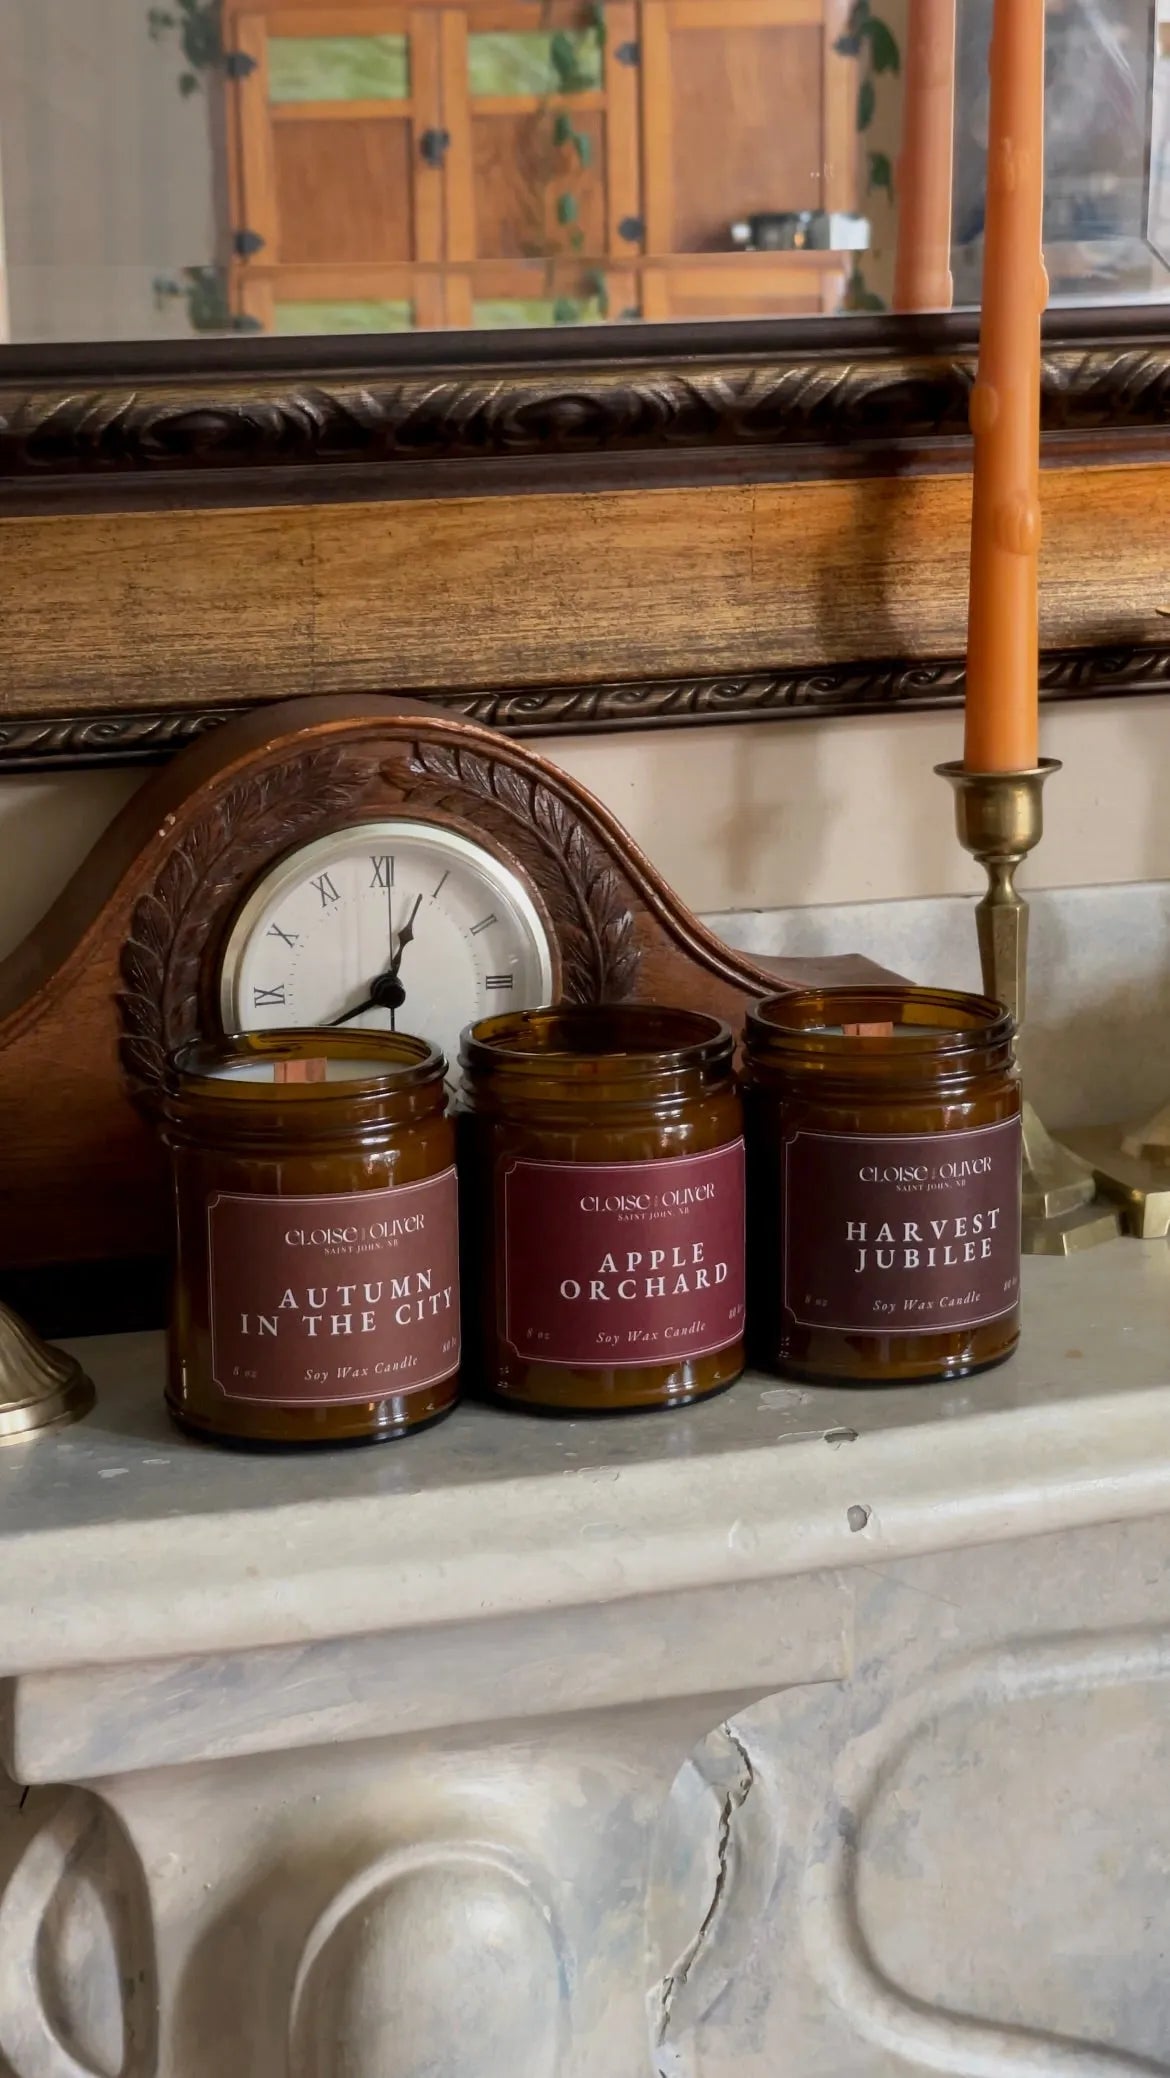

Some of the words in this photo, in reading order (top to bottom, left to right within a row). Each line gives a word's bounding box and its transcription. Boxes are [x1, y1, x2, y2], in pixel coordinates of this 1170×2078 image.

[310, 872, 341, 908] XI
[266, 923, 299, 949] X
[253, 984, 286, 1008] IX
[485, 974, 513, 990] III
[845, 1208, 1000, 1242] HARVEST
[598, 1242, 705, 1273] APPLE
[854, 1237, 993, 1273] JUBILEE
[278, 1269, 433, 1309] AUTUMN
[560, 1262, 728, 1301] ORCHARD
[240, 1313, 279, 1337] IN
[302, 1311, 377, 1337] THE
[395, 1286, 453, 1326] CITY
[872, 1300, 896, 1315] Soy
[903, 1298, 933, 1312] Wax
[939, 1292, 982, 1308] Candle
[596, 1332, 620, 1346] Soy
[628, 1331, 659, 1343] Wax
[664, 1321, 707, 1339] Candle
[304, 1369, 329, 1383] Soy
[337, 1366, 369, 1380] Wax
[374, 1355, 418, 1374] Candle
